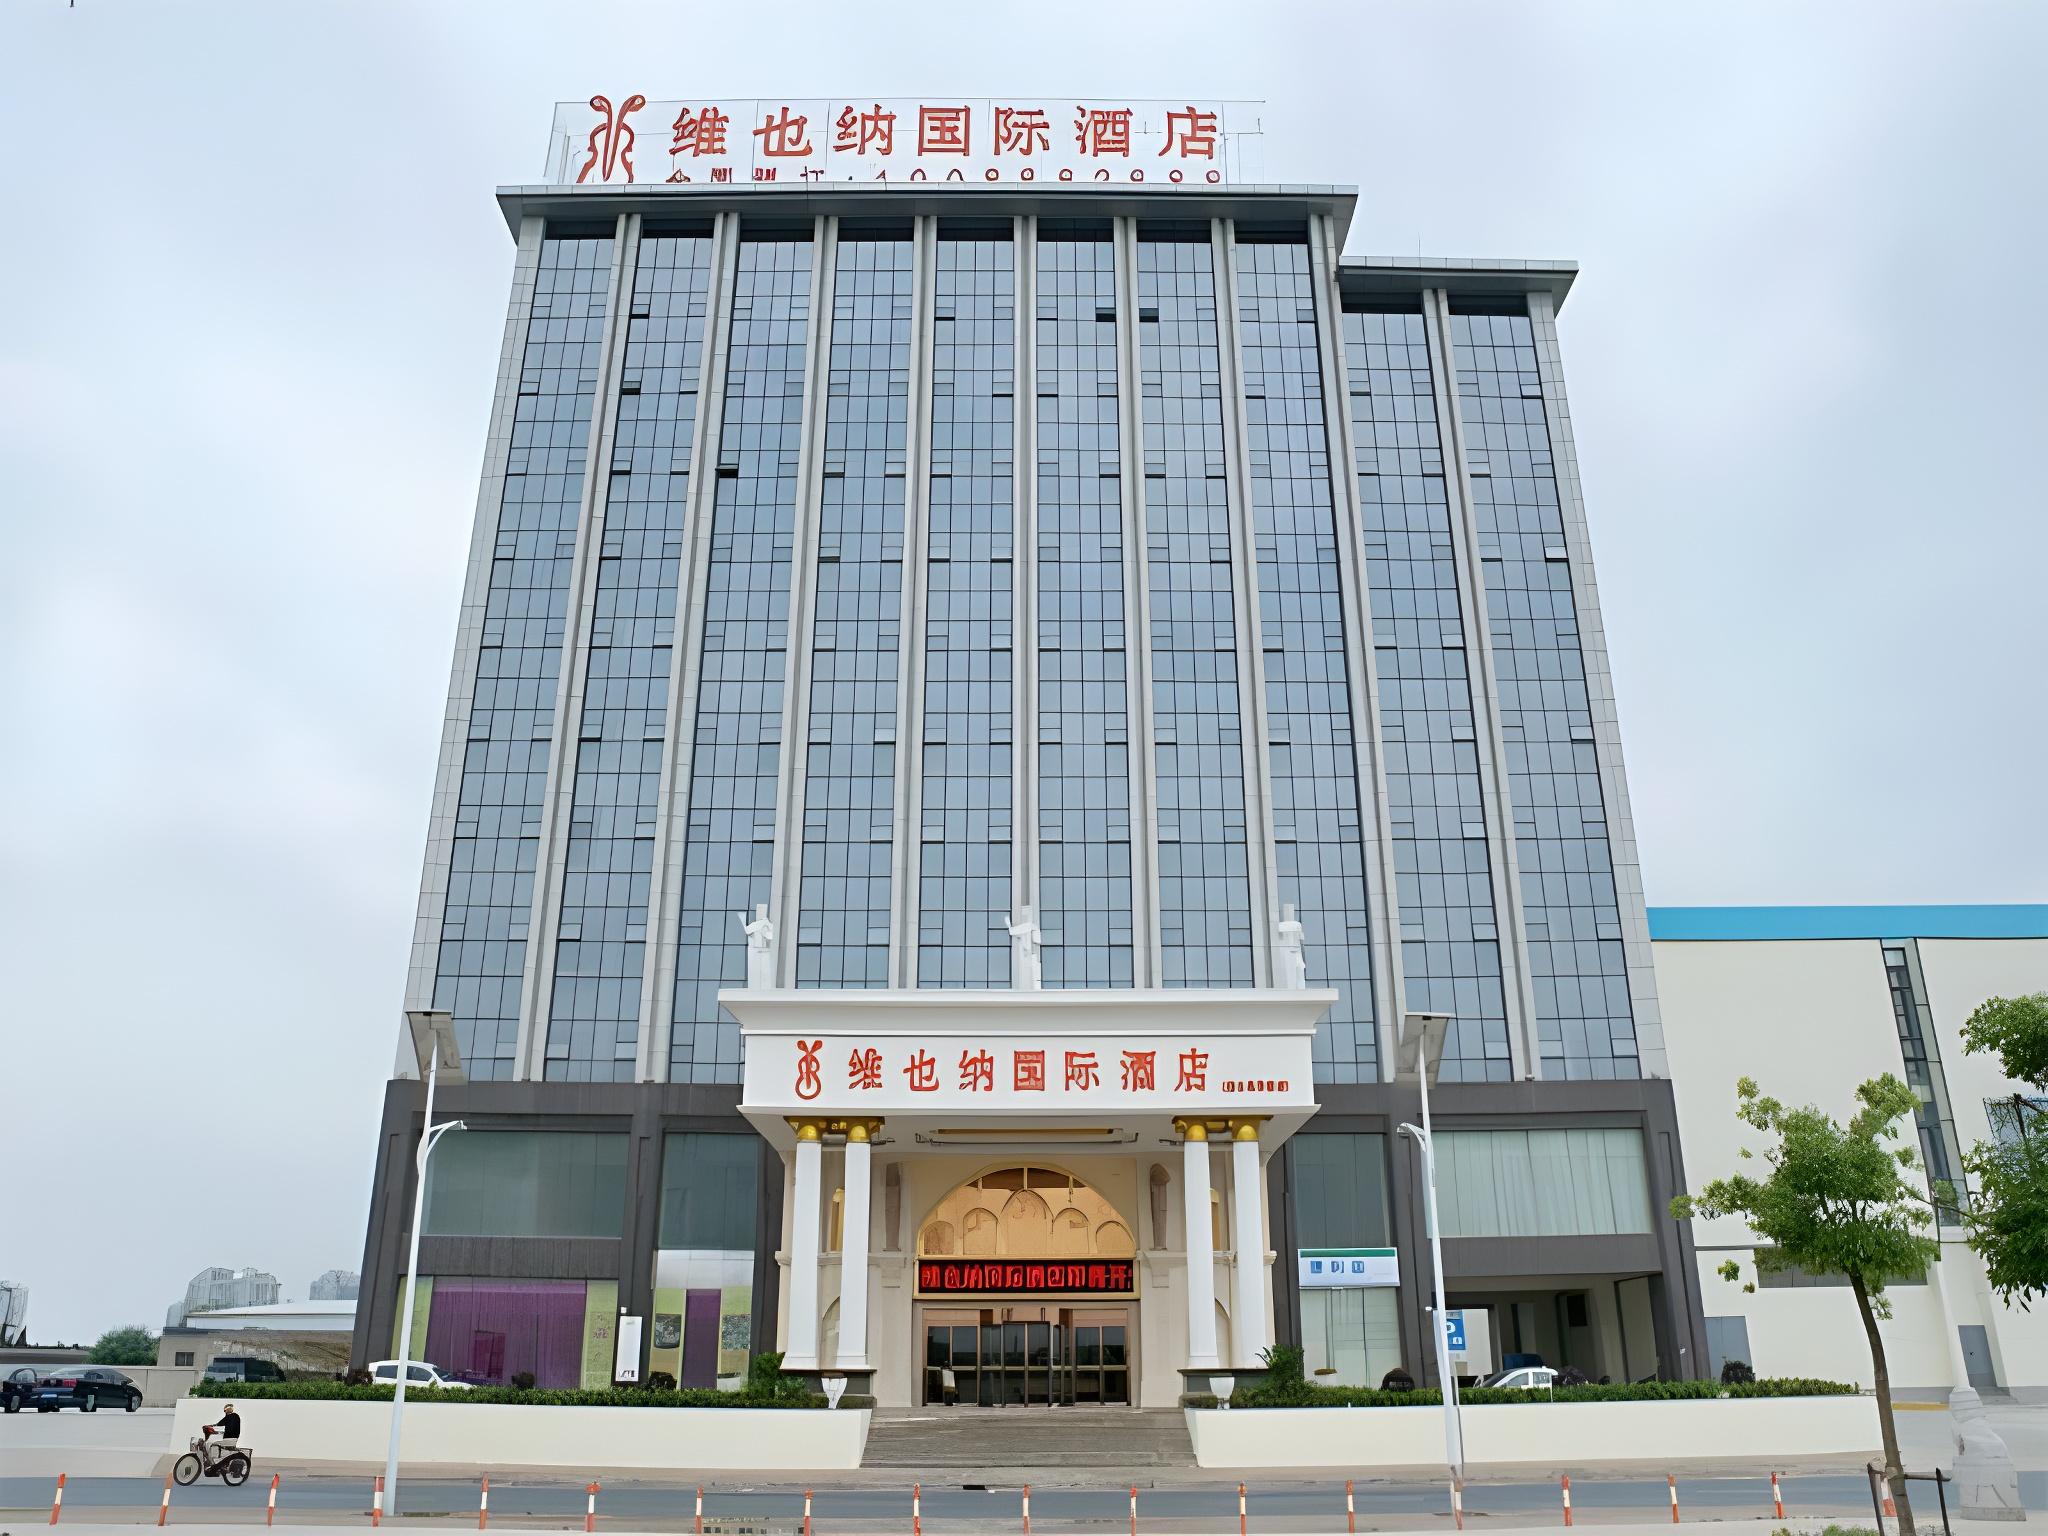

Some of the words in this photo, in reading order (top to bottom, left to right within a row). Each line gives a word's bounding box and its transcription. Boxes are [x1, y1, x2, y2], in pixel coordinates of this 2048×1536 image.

[669, 104, 1217, 160] 维也纳国际酒店
[848, 1048, 1209, 1092] 维也纳国际酒店
